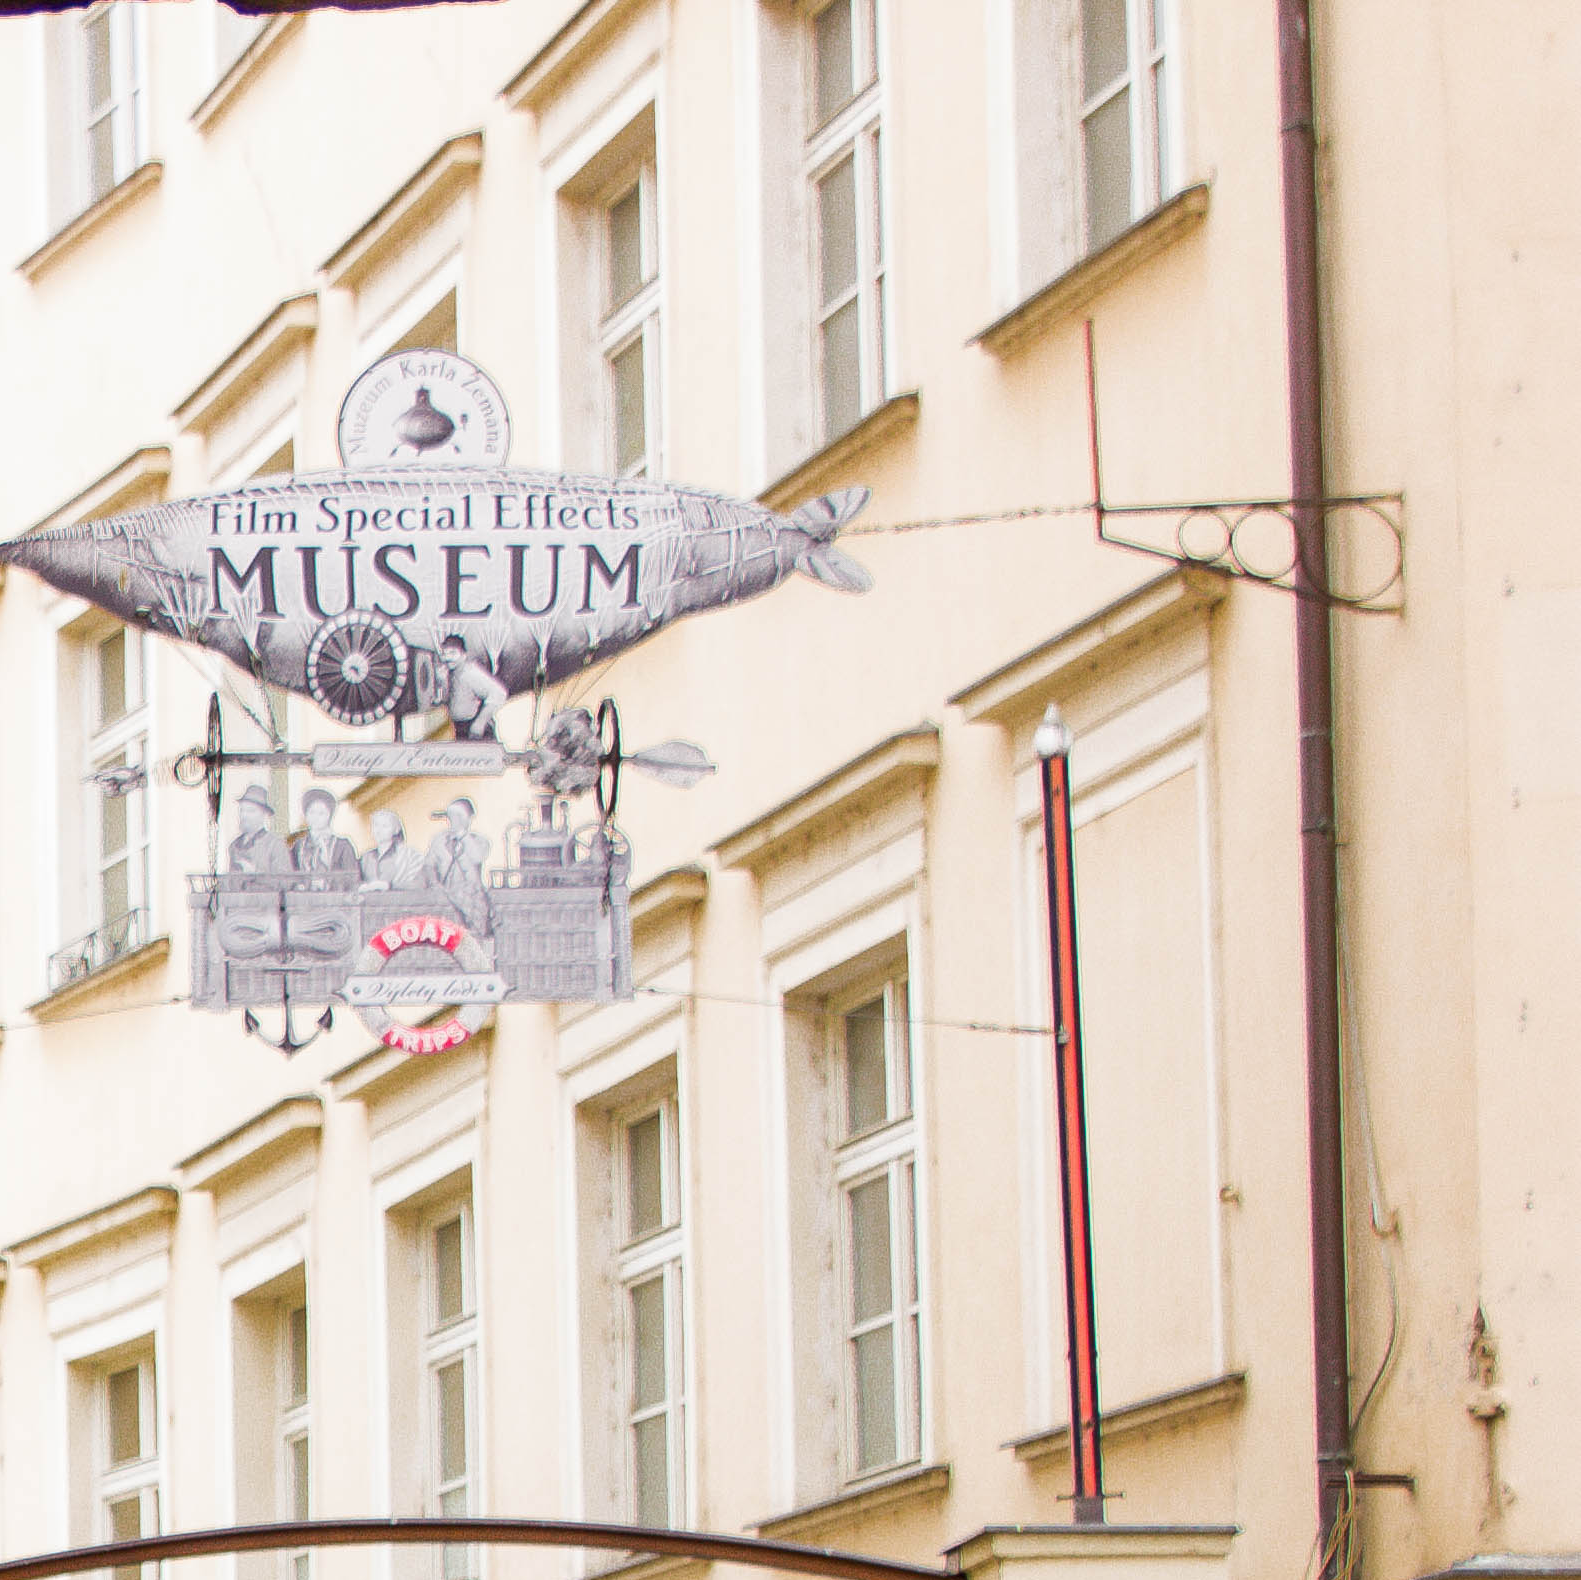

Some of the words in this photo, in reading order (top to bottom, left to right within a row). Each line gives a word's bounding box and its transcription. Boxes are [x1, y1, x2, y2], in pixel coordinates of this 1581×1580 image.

[399, 359, 456, 382] Karla
[210, 500, 299, 536] Film
[316, 494, 471, 543] Special
[491, 494, 639, 531] Effects
[206, 543, 644, 622] MUSEUM
[380, 922, 456, 951] BOAT
[389, 1024, 466, 1051] TRIPS
